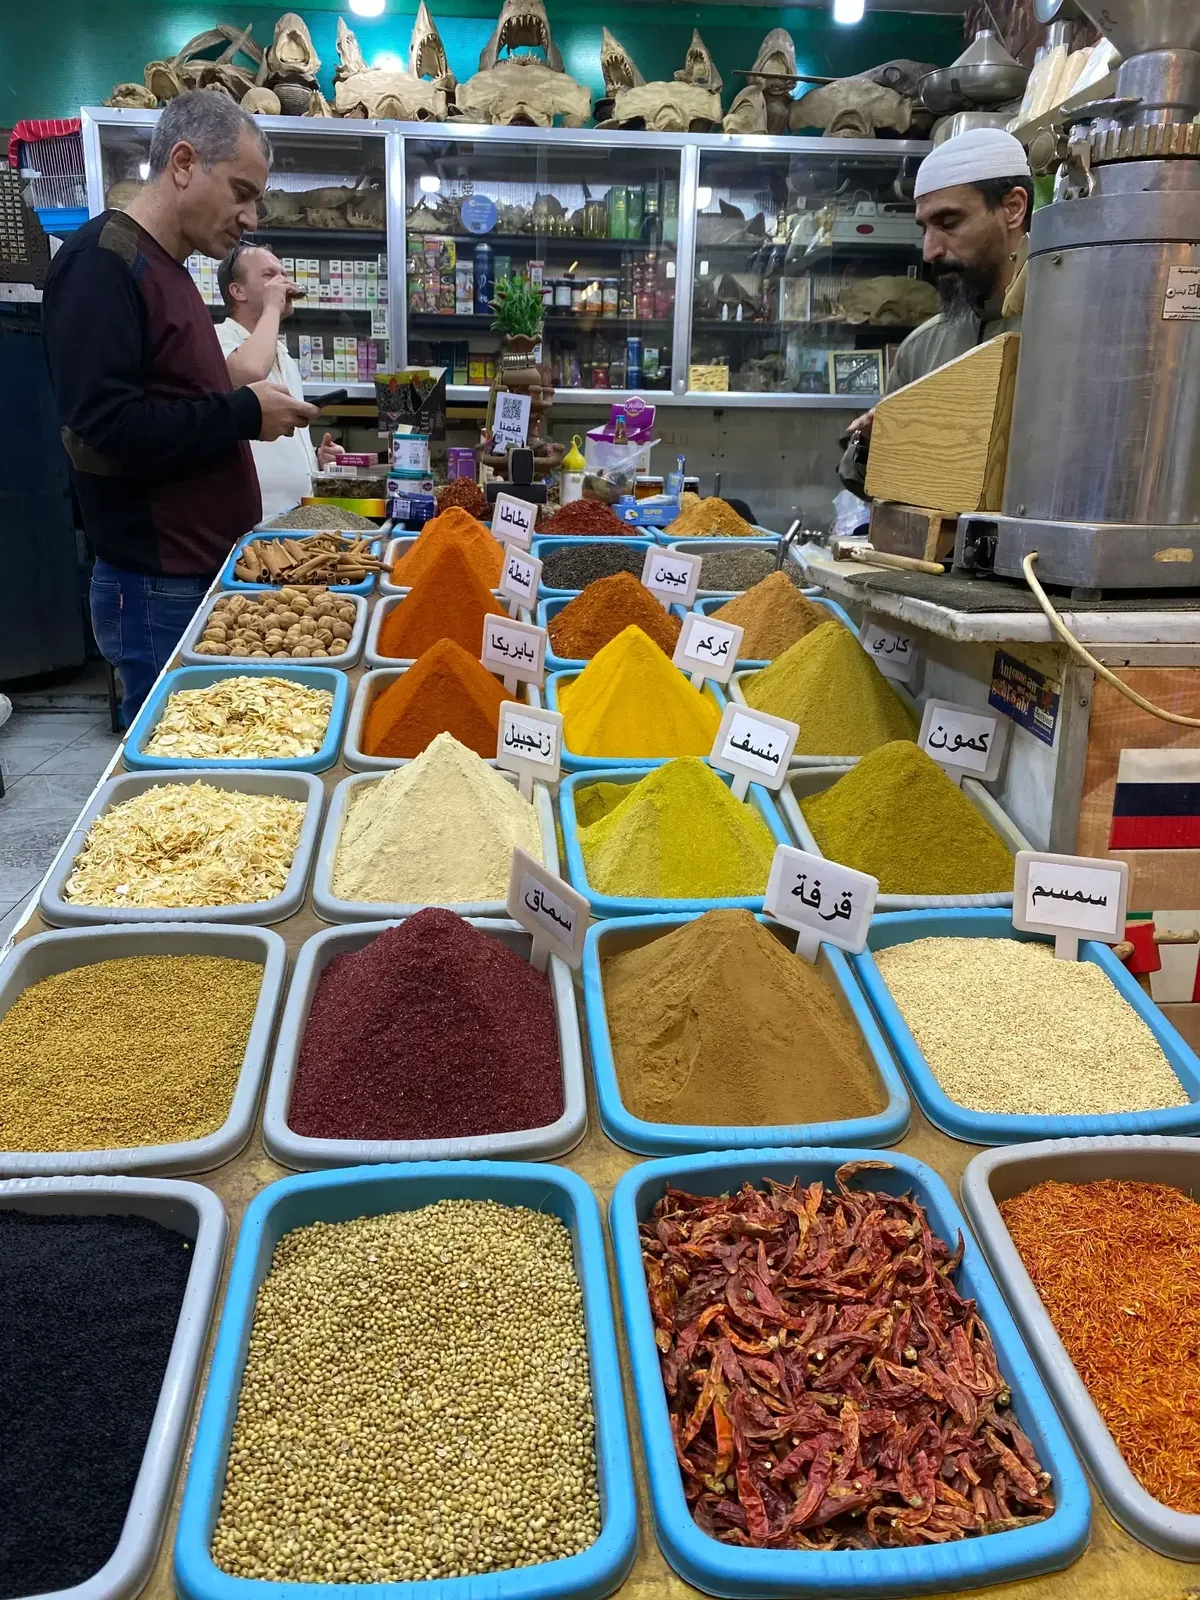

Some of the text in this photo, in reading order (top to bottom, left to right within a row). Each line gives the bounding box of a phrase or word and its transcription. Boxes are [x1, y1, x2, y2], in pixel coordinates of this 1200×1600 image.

[501, 507, 528, 532] بطاطا
[509, 560, 530, 587] شطة
[655, 568, 687, 586] كيجن
[492, 634, 534, 662] بابريكا
[697, 637, 729, 656] كركم
[873, 635, 910, 653] كاري
[505, 724, 550, 756] زنجبيل
[730, 733, 779, 764] منسف
[929, 726, 990, 753] كمون
[791, 874, 852, 920] قرفة
[1032, 886, 1107, 906] سمسم
[524, 889, 572, 932] سماق
